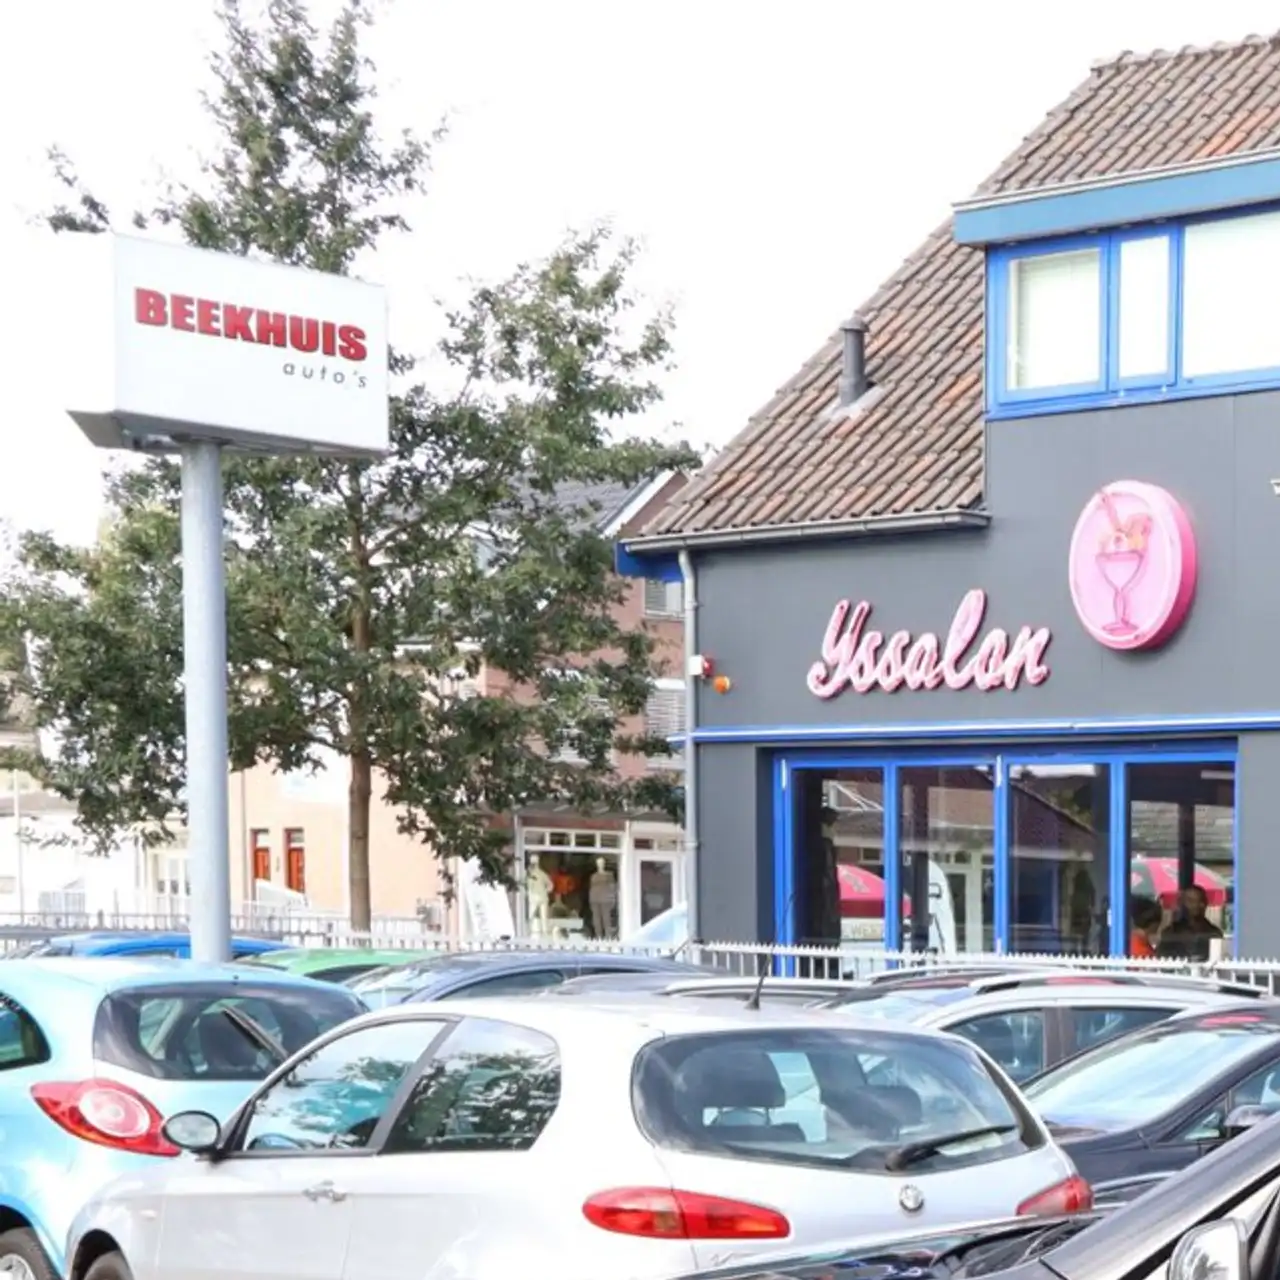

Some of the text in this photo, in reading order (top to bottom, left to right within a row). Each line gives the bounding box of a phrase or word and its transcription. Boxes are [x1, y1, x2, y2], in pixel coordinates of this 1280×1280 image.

[134, 287, 367, 362] BEEKHUIS
[282, 362, 367, 388] auto's
[806, 588, 1052, 700] Yssalon
